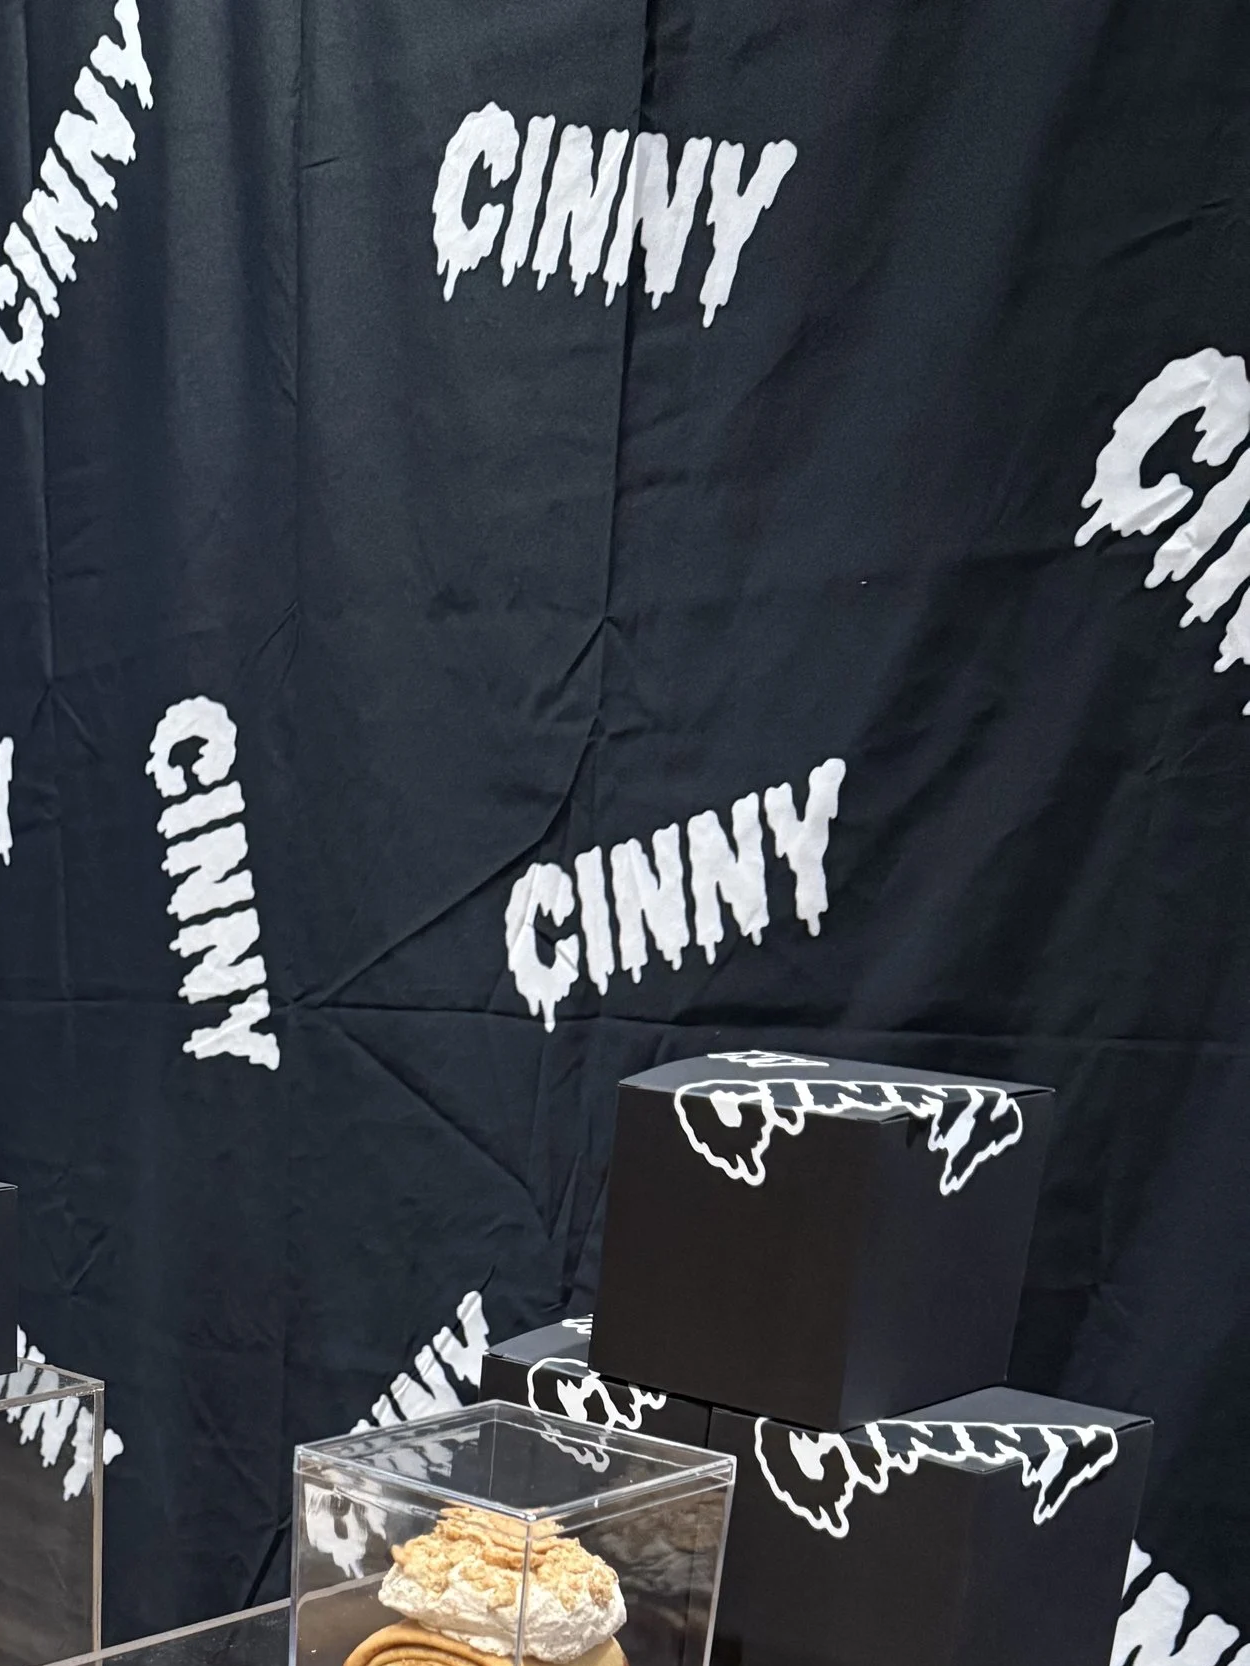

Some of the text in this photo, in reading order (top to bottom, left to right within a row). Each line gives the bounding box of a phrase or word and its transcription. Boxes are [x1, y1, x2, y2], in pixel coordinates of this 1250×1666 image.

[432, 102, 798, 328] CINNY
[146, 696, 281, 1071] CINNY
[505, 758, 847, 1032] CINNY
